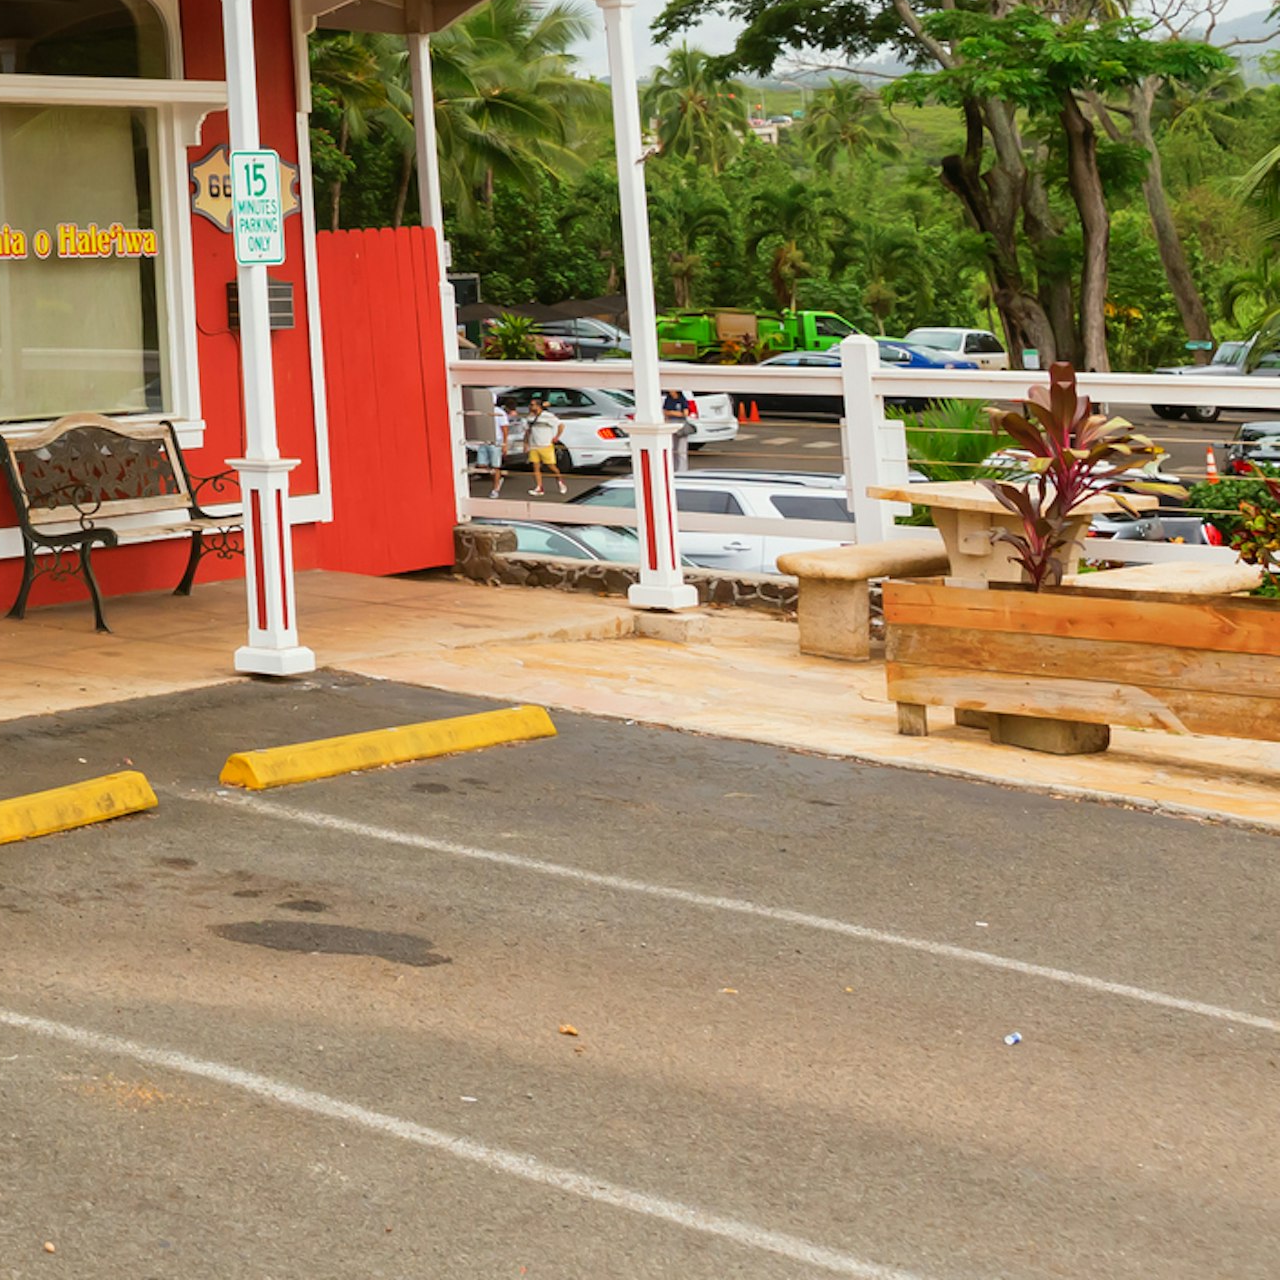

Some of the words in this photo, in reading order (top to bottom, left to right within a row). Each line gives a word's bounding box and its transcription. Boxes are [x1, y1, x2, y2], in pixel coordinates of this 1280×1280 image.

[244, 163, 267, 197] 15
[238, 199, 277, 215] MINUTES
[239, 217, 277, 233] PARKING
[34, 229, 53, 259] o
[247, 235, 271, 252] ONLY
